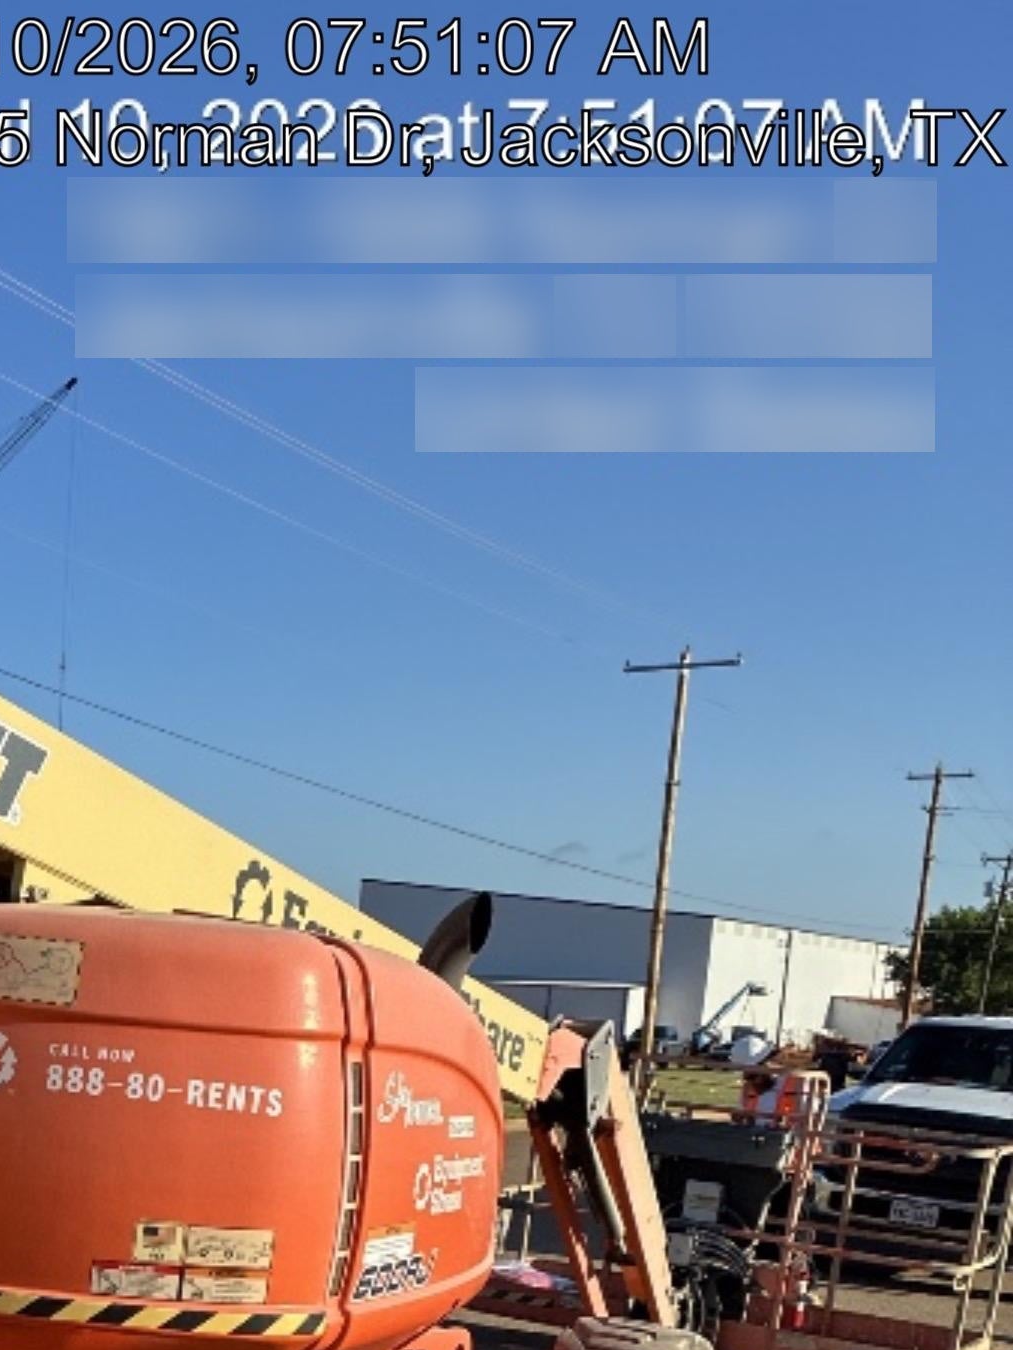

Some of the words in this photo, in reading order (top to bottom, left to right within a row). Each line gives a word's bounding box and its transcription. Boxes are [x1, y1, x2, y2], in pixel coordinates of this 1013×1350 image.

[49, 1043, 90, 1060] CALL
[97, 1046, 135, 1063] NOW
[46, 1064, 283, 1118] 888-80-RENTS
